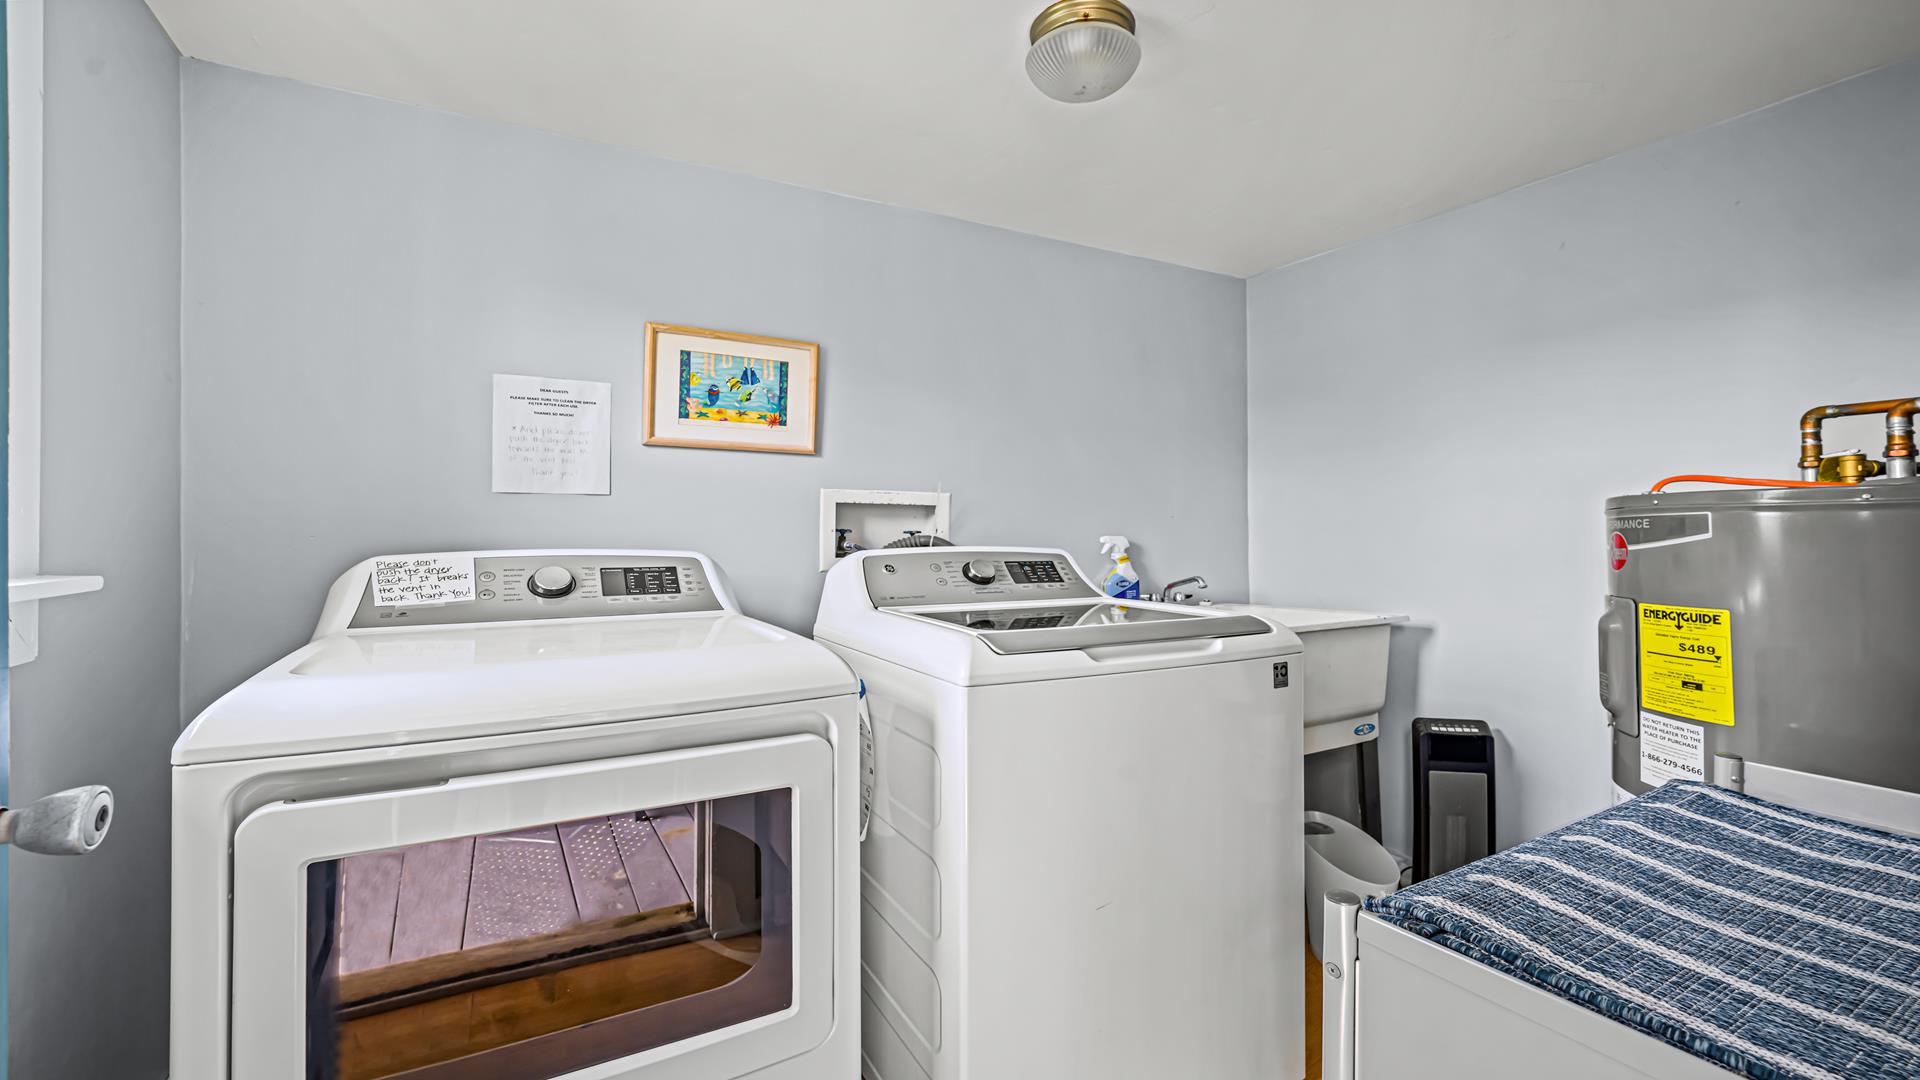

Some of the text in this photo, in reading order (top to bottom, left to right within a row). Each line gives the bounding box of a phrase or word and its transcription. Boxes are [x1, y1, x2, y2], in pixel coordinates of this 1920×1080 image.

[376, 559, 438, 570] Please don't
[376, 568, 401, 578] push
[424, 566, 453, 575] dryer
[437, 573, 469, 582] breaks
[398, 584, 426, 593] vent
[414, 591, 448, 600] Thank
[448, 587, 472, 598] You!
[1643, 608, 1722, 625] ENERGYGUIDE
[1678, 642, 1716, 656] $489
[1658, 728, 1678, 737] HEATER
[1662, 722, 1685, 732] RETURN
[1668, 738, 1698, 750] PURCHASE
[1642, 751, 1702, 776] 1-866-279-4566
